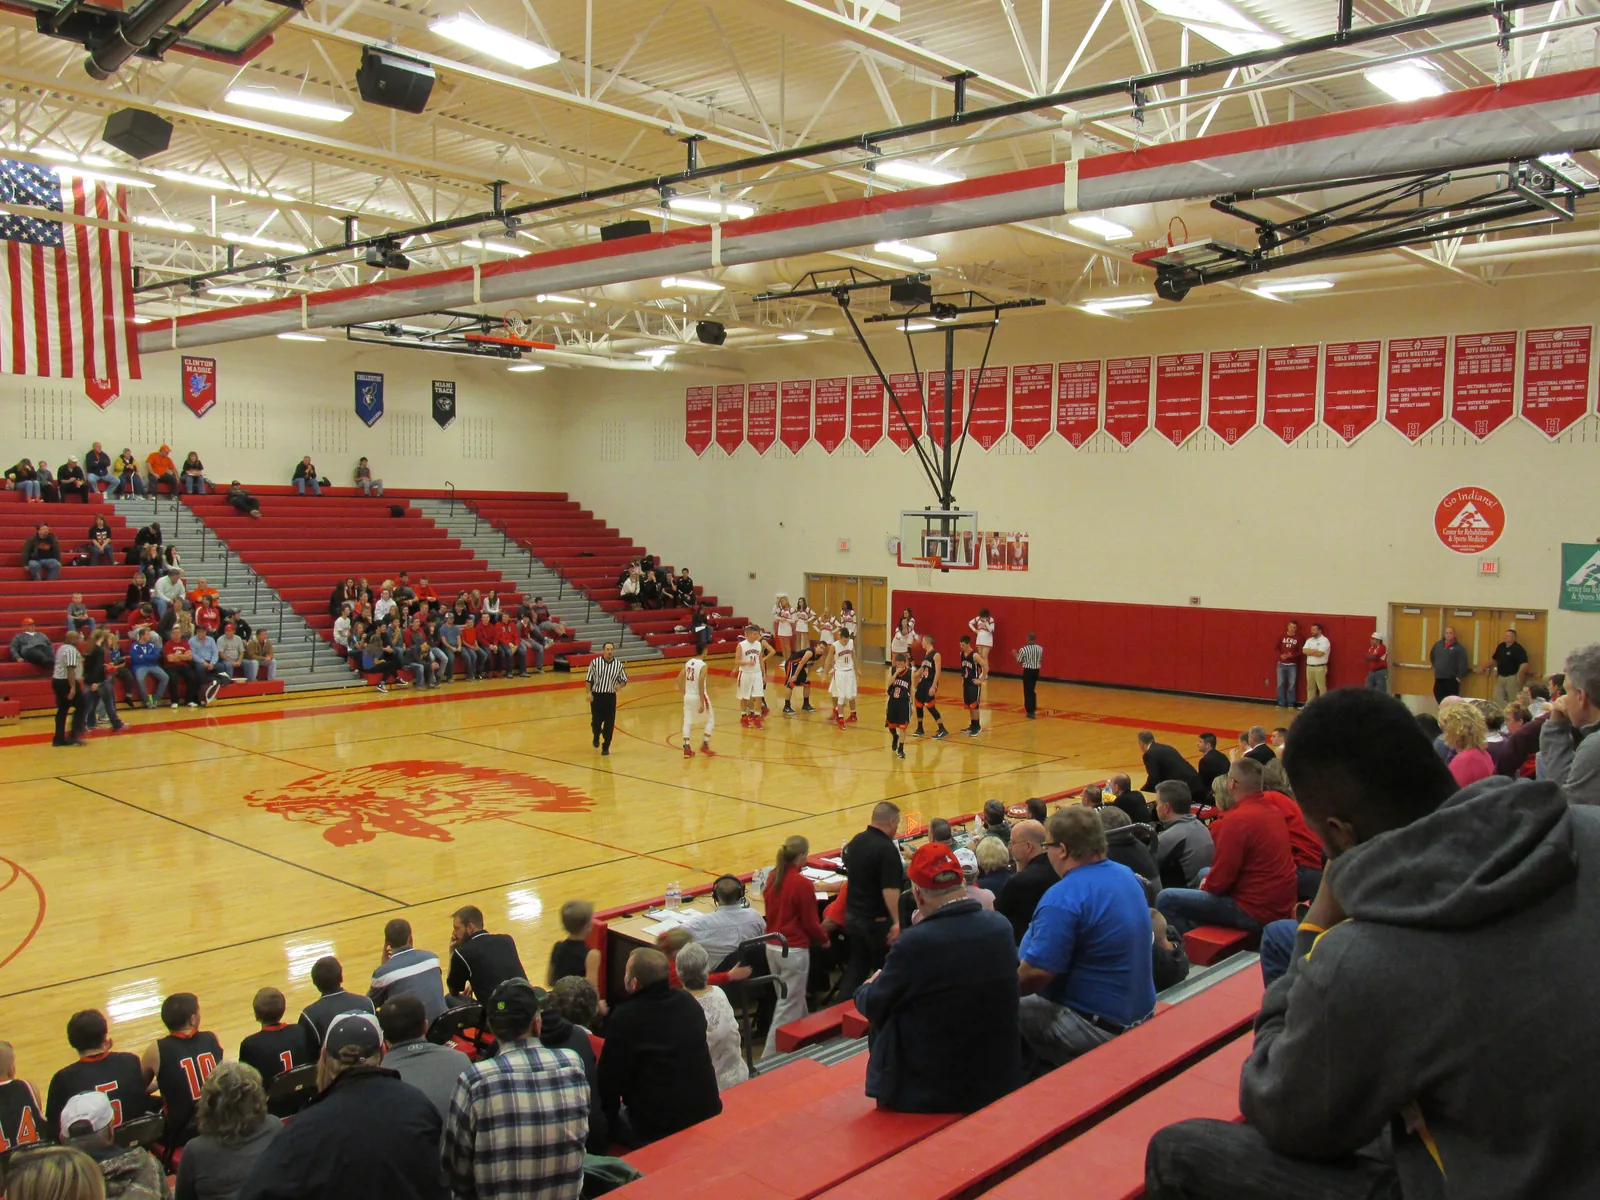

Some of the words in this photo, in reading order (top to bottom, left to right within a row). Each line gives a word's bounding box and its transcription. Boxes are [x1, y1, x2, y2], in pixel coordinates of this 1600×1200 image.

[1479, 345, 1506, 353] BASEBALL
[1551, 340, 1580, 348] SOFTBALL
[1347, 353, 1373, 361] SWIMMING
[1409, 349, 1439, 357] WRESTLING
[184, 358, 214, 368] CLINTON
[186, 365, 212, 374] MASSIE
[434, 381, 453, 389] MIAMI
[434, 387, 453, 395] TRACE
[1342, 424, 1355, 438] H
[1406, 423, 1420, 437] H
[1474, 420, 1489, 435] H
[1545, 418, 1560, 433] H
[1072, 432, 1082, 445] H
[1121, 431, 1131, 444] H
[1172, 429, 1182, 442] H
[1225, 427, 1237, 441] H
[1282, 426, 1295, 441] H
[1026, 434, 1036, 446] H
[1443, 497, 1457, 508] Go
[1457, 489, 1498, 508] Indians!
[1442, 527, 1458, 535] Center
[1464, 528, 1495, 536] Rehabilitation
[1453, 535, 1467, 544] Sports
[1467, 535, 1488, 543] Medicine
[1482, 562, 1496, 571] EXIT
[686, 667, 695, 681] 23
